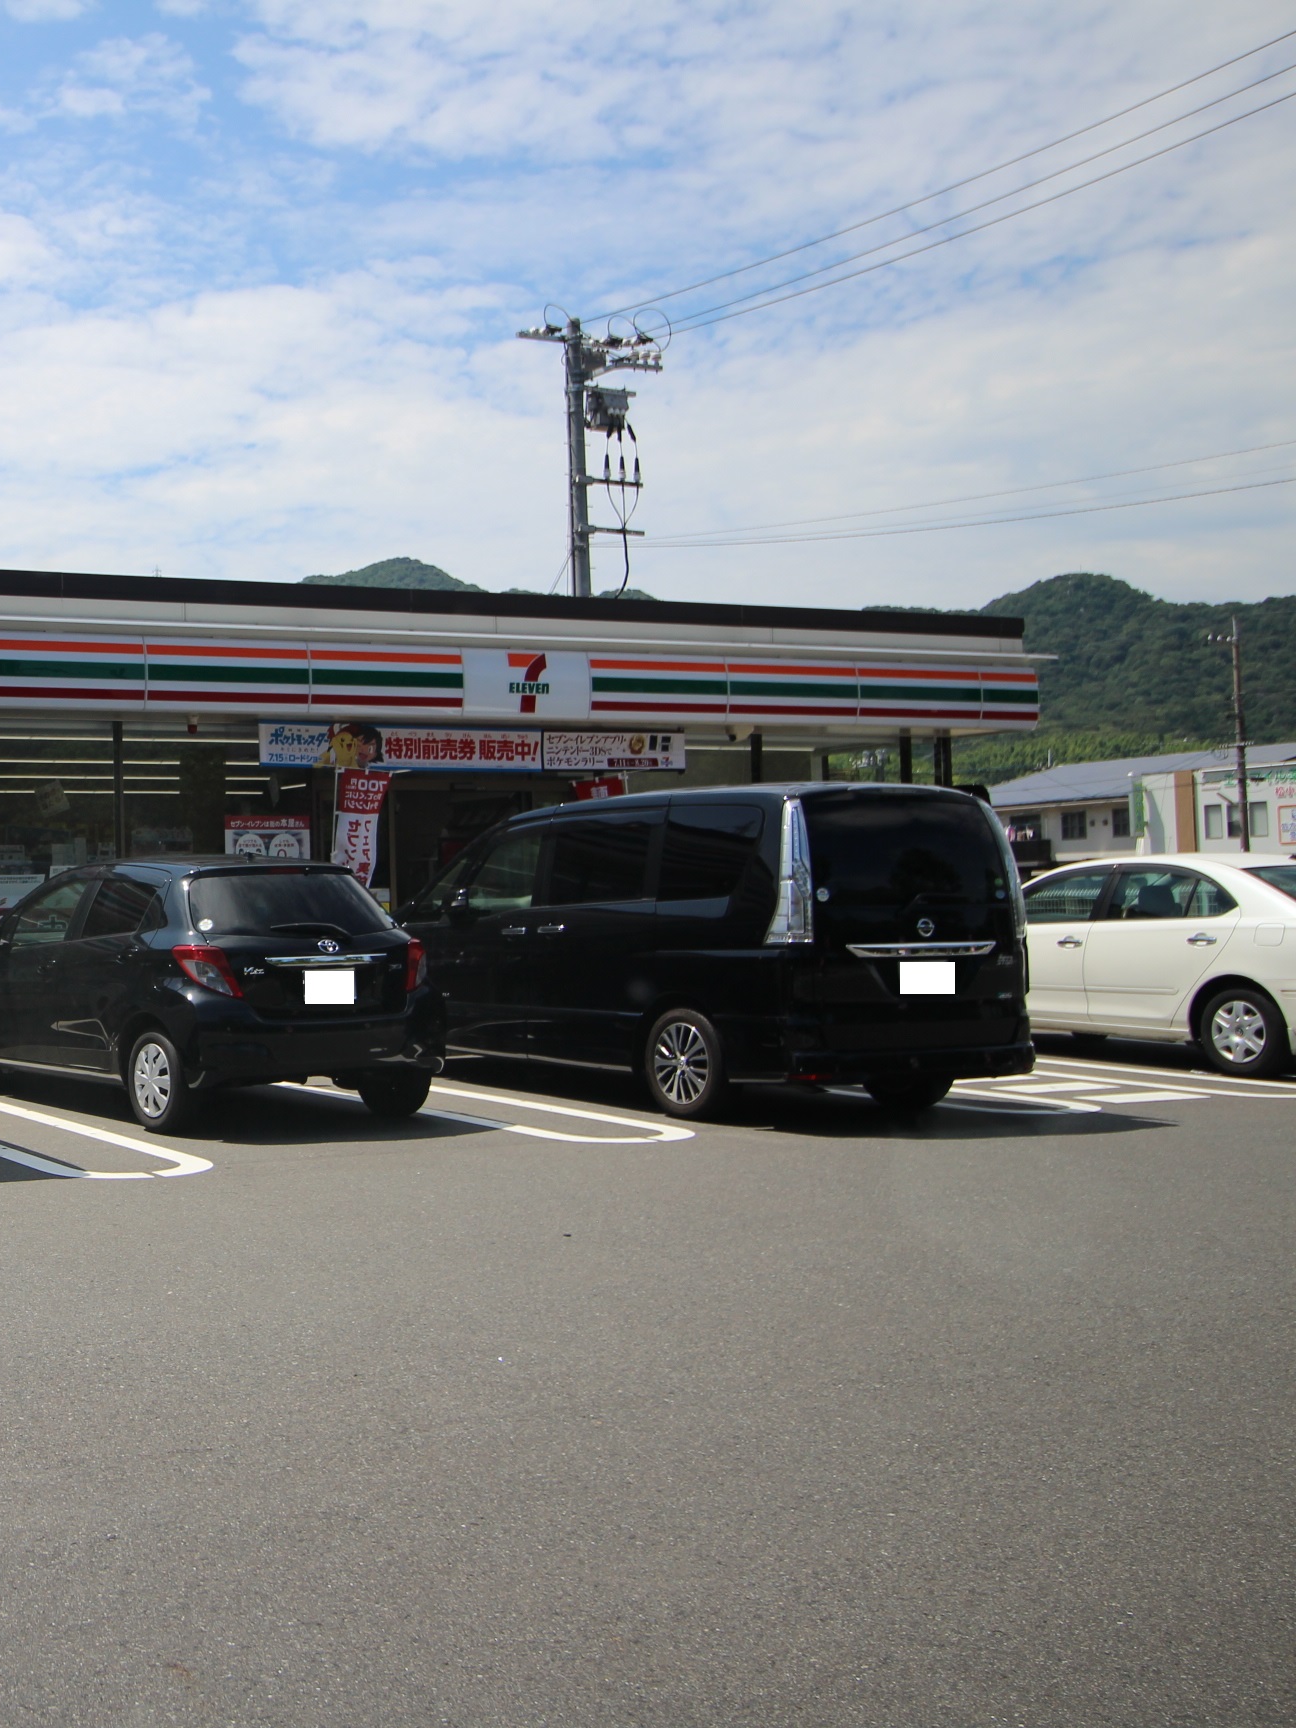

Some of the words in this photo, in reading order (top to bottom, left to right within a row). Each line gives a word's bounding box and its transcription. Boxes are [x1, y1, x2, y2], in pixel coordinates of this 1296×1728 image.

[385, 737, 475, 761] 特別前売券
[546, 757, 604, 767] ポケモンラリー
